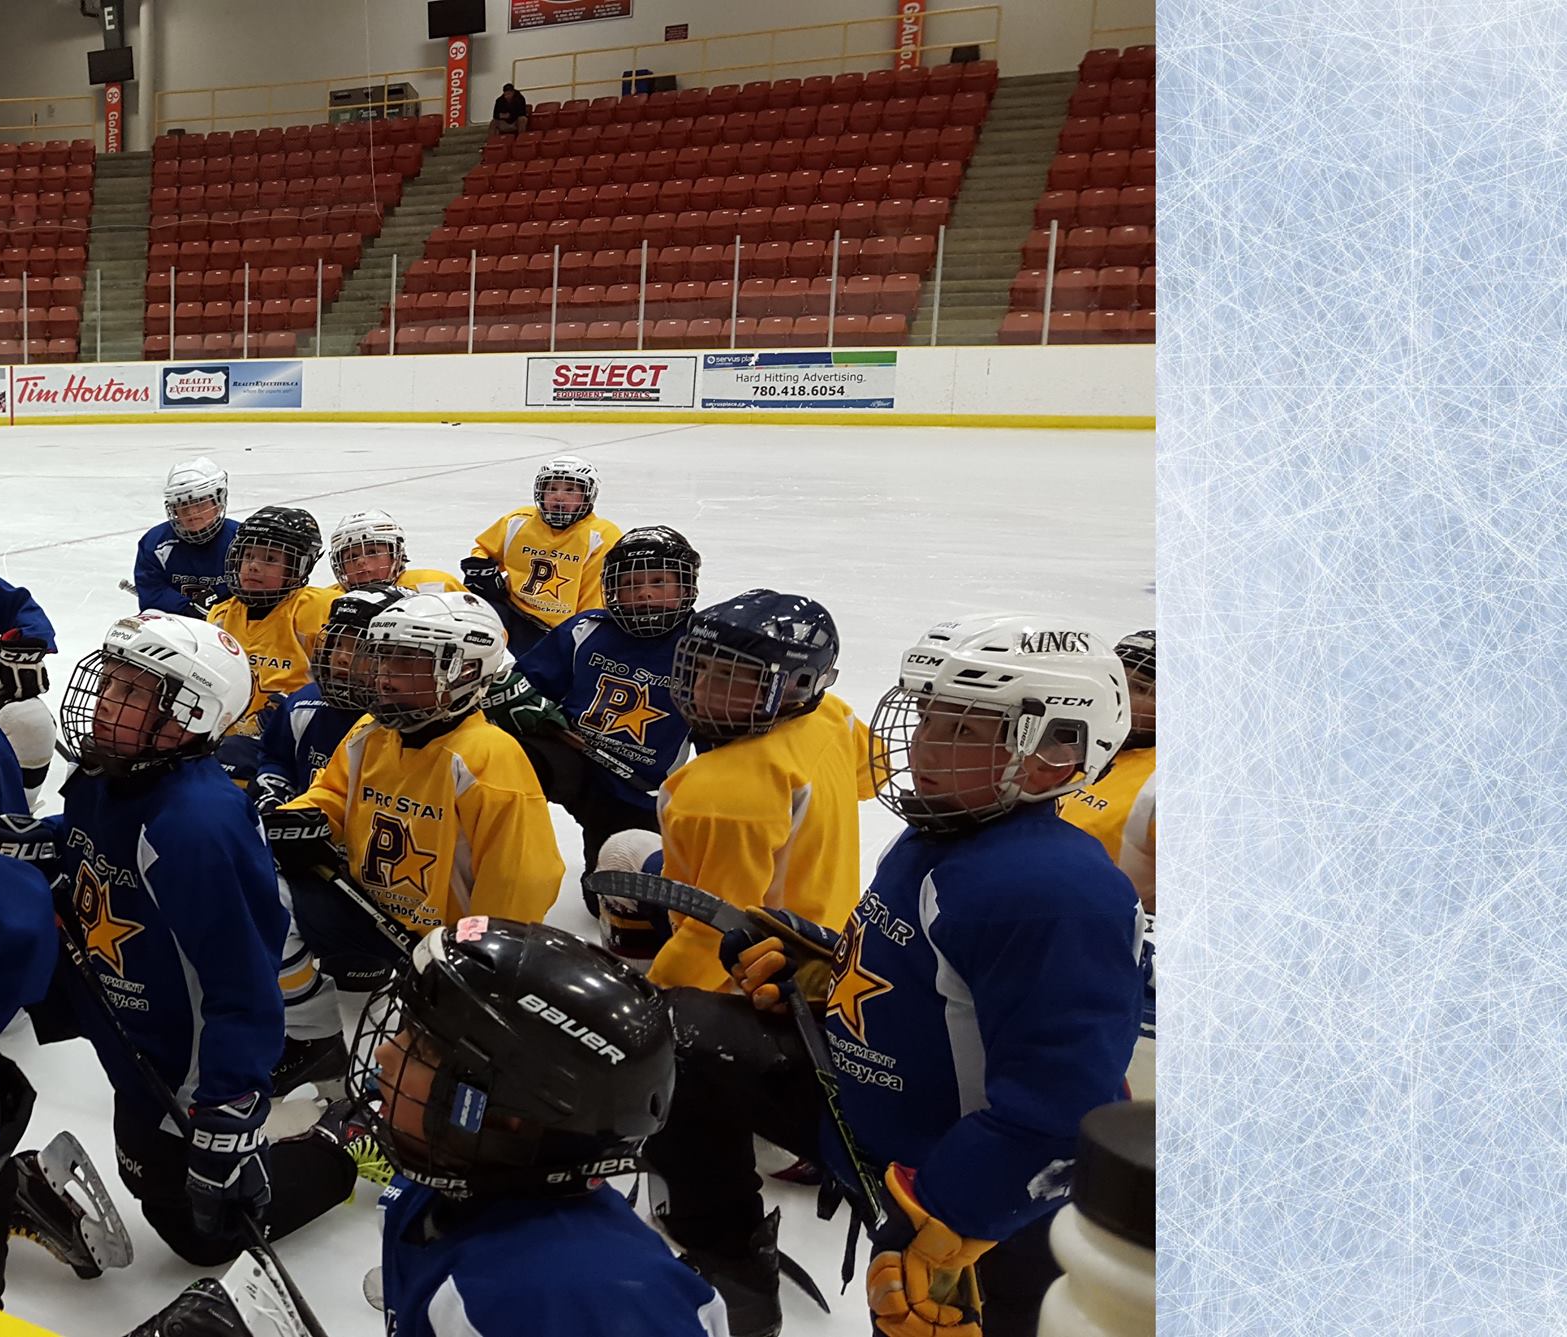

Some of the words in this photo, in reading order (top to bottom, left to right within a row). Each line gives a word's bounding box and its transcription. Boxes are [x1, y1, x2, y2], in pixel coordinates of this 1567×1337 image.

[103, 6, 115, 30] E
[715, 356, 741, 364] servus
[179, 377, 214, 385] REALTY
[552, 364, 668, 387] SELECT
[736, 373, 761, 383] Hard
[764, 372, 799, 384] Hitting
[16, 376, 58, 404] Tim
[63, 374, 150, 402] Hortons
[169, 385, 222, 394] EXECUTIVES
[556, 390, 606, 399] EQUIPMENT
[611, 390, 651, 399] RENTALS
[752, 385, 845, 397] 780.418.6054
[522, 546, 546, 556] PRO
[549, 549, 580, 563] STAR
[465, 635, 493, 646] BAUER
[1020, 631, 1090, 654] KINGS
[249, 655, 292, 670] STAR
[588, 652, 630, 676] PRO
[907, 654, 945, 667] CCM
[191, 671, 214, 688] Reebok
[1044, 696, 1094, 708] CCM
[1070, 788, 1109, 812] TAR
[94, 852, 136, 889] STA
[517, 993, 627, 1066] BAUER
[402, 1168, 468, 1190] AUER
[545, 1157, 637, 1184] BUER
